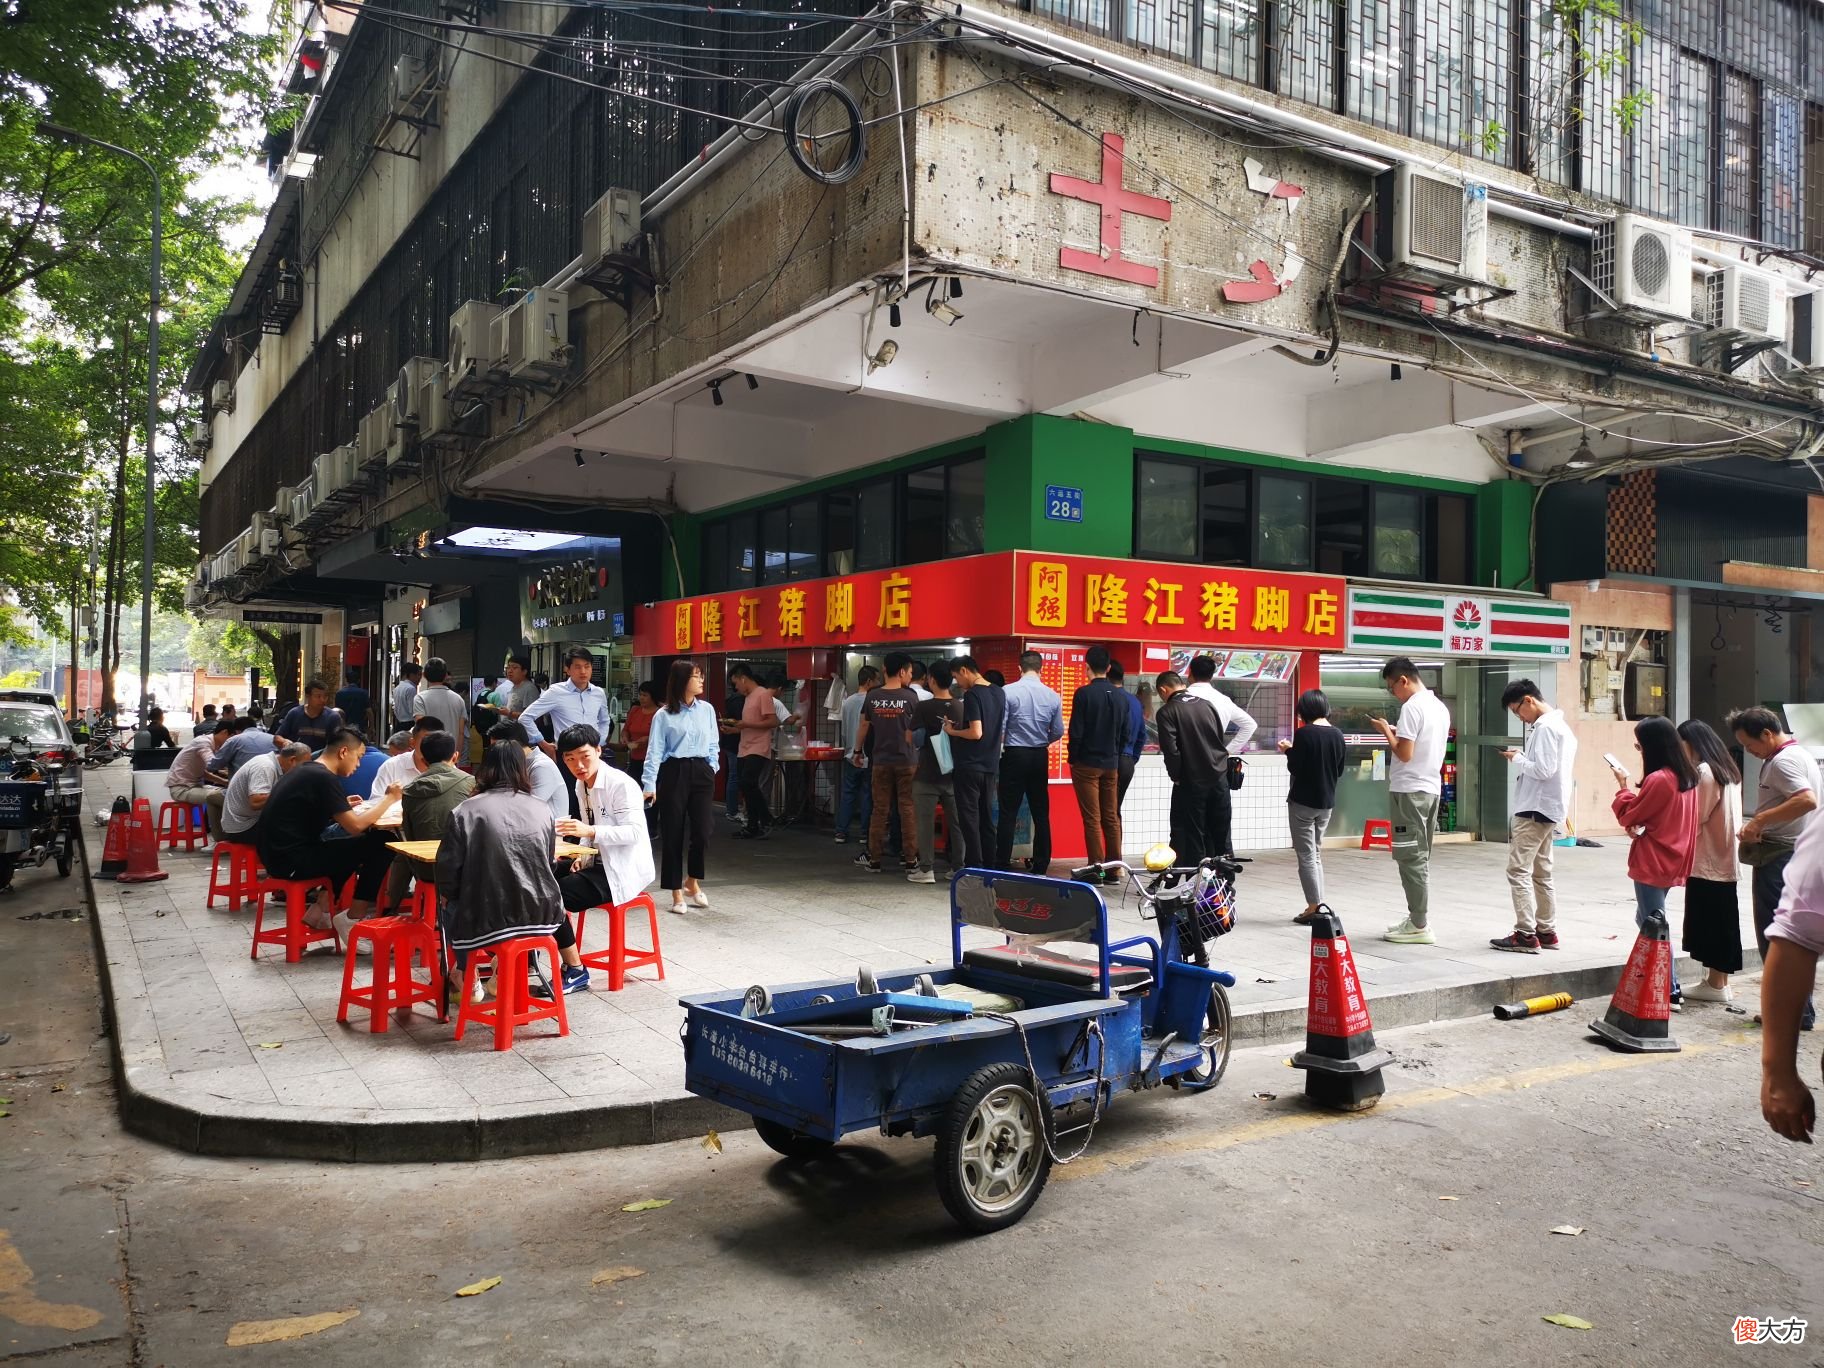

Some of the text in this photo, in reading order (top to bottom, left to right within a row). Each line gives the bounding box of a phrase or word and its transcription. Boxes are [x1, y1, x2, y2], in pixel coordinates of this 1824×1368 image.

[1051, 500, 1070, 517] 28
[701, 572, 912, 644] 隆江猪脚店
[1036, 565, 1063, 623] 阿强
[1085, 573, 1338, 635] 隆江猪脚店
[1450, 635, 1484, 651] 福万家
